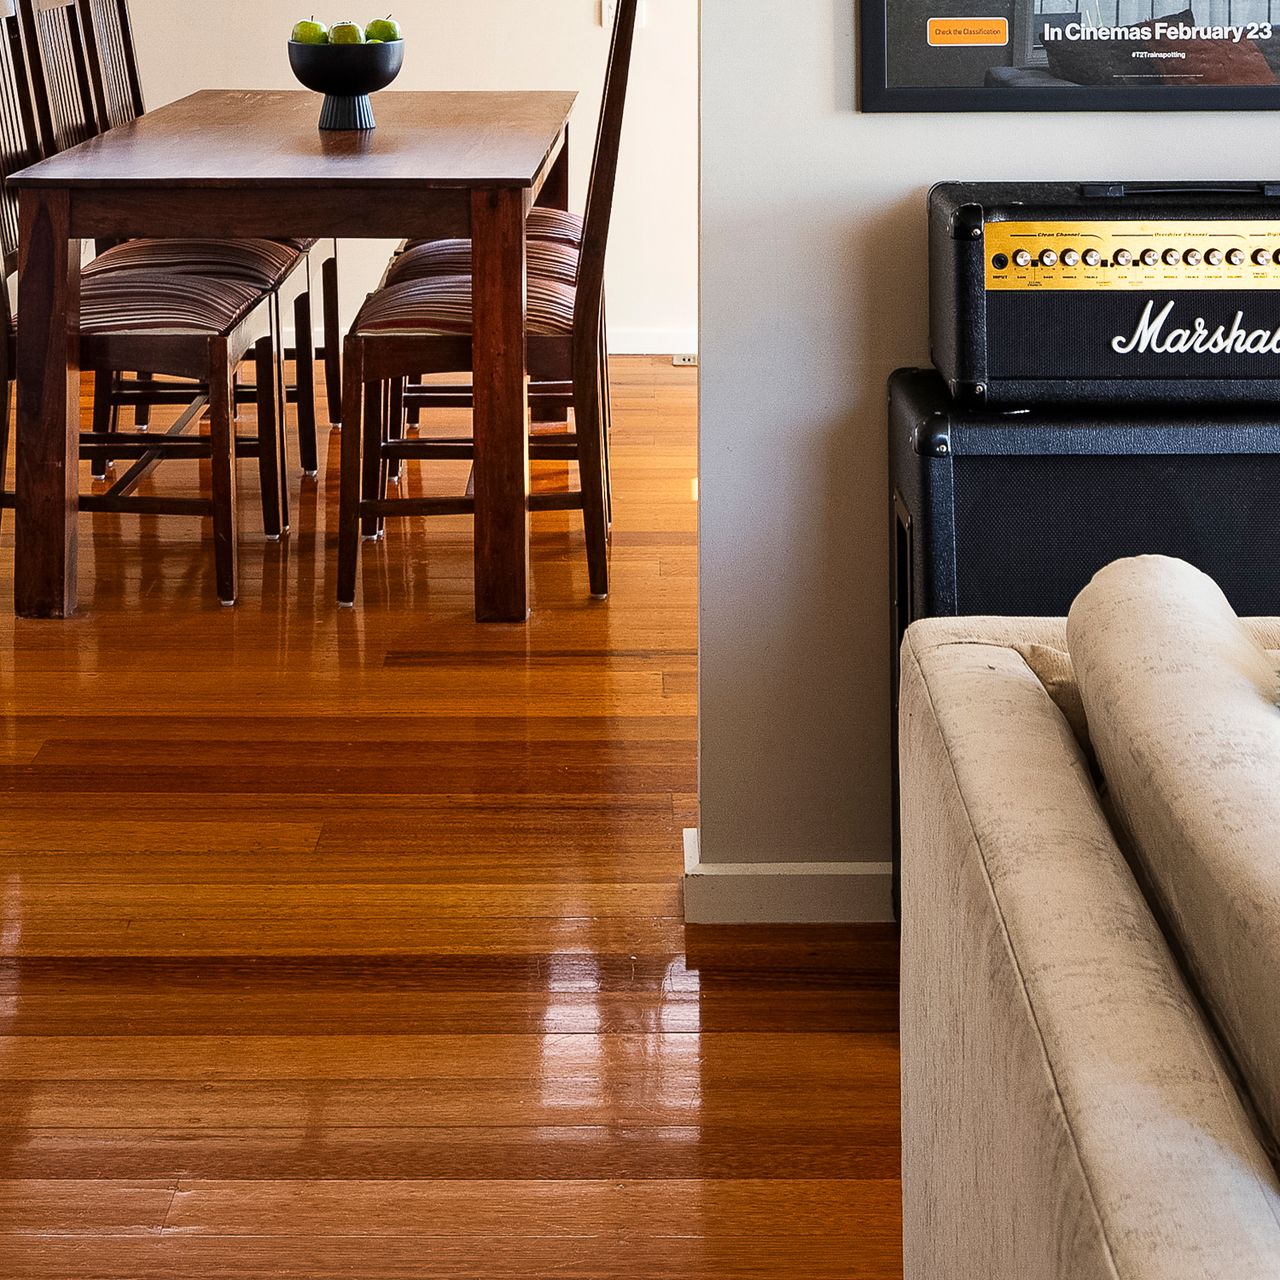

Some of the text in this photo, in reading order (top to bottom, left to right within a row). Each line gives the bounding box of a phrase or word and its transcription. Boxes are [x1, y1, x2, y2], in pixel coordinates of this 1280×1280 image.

[1044, 22, 1273, 43] In Cinemas February 23
[1131, 51, 1186, 60] #T2Trainspotting
